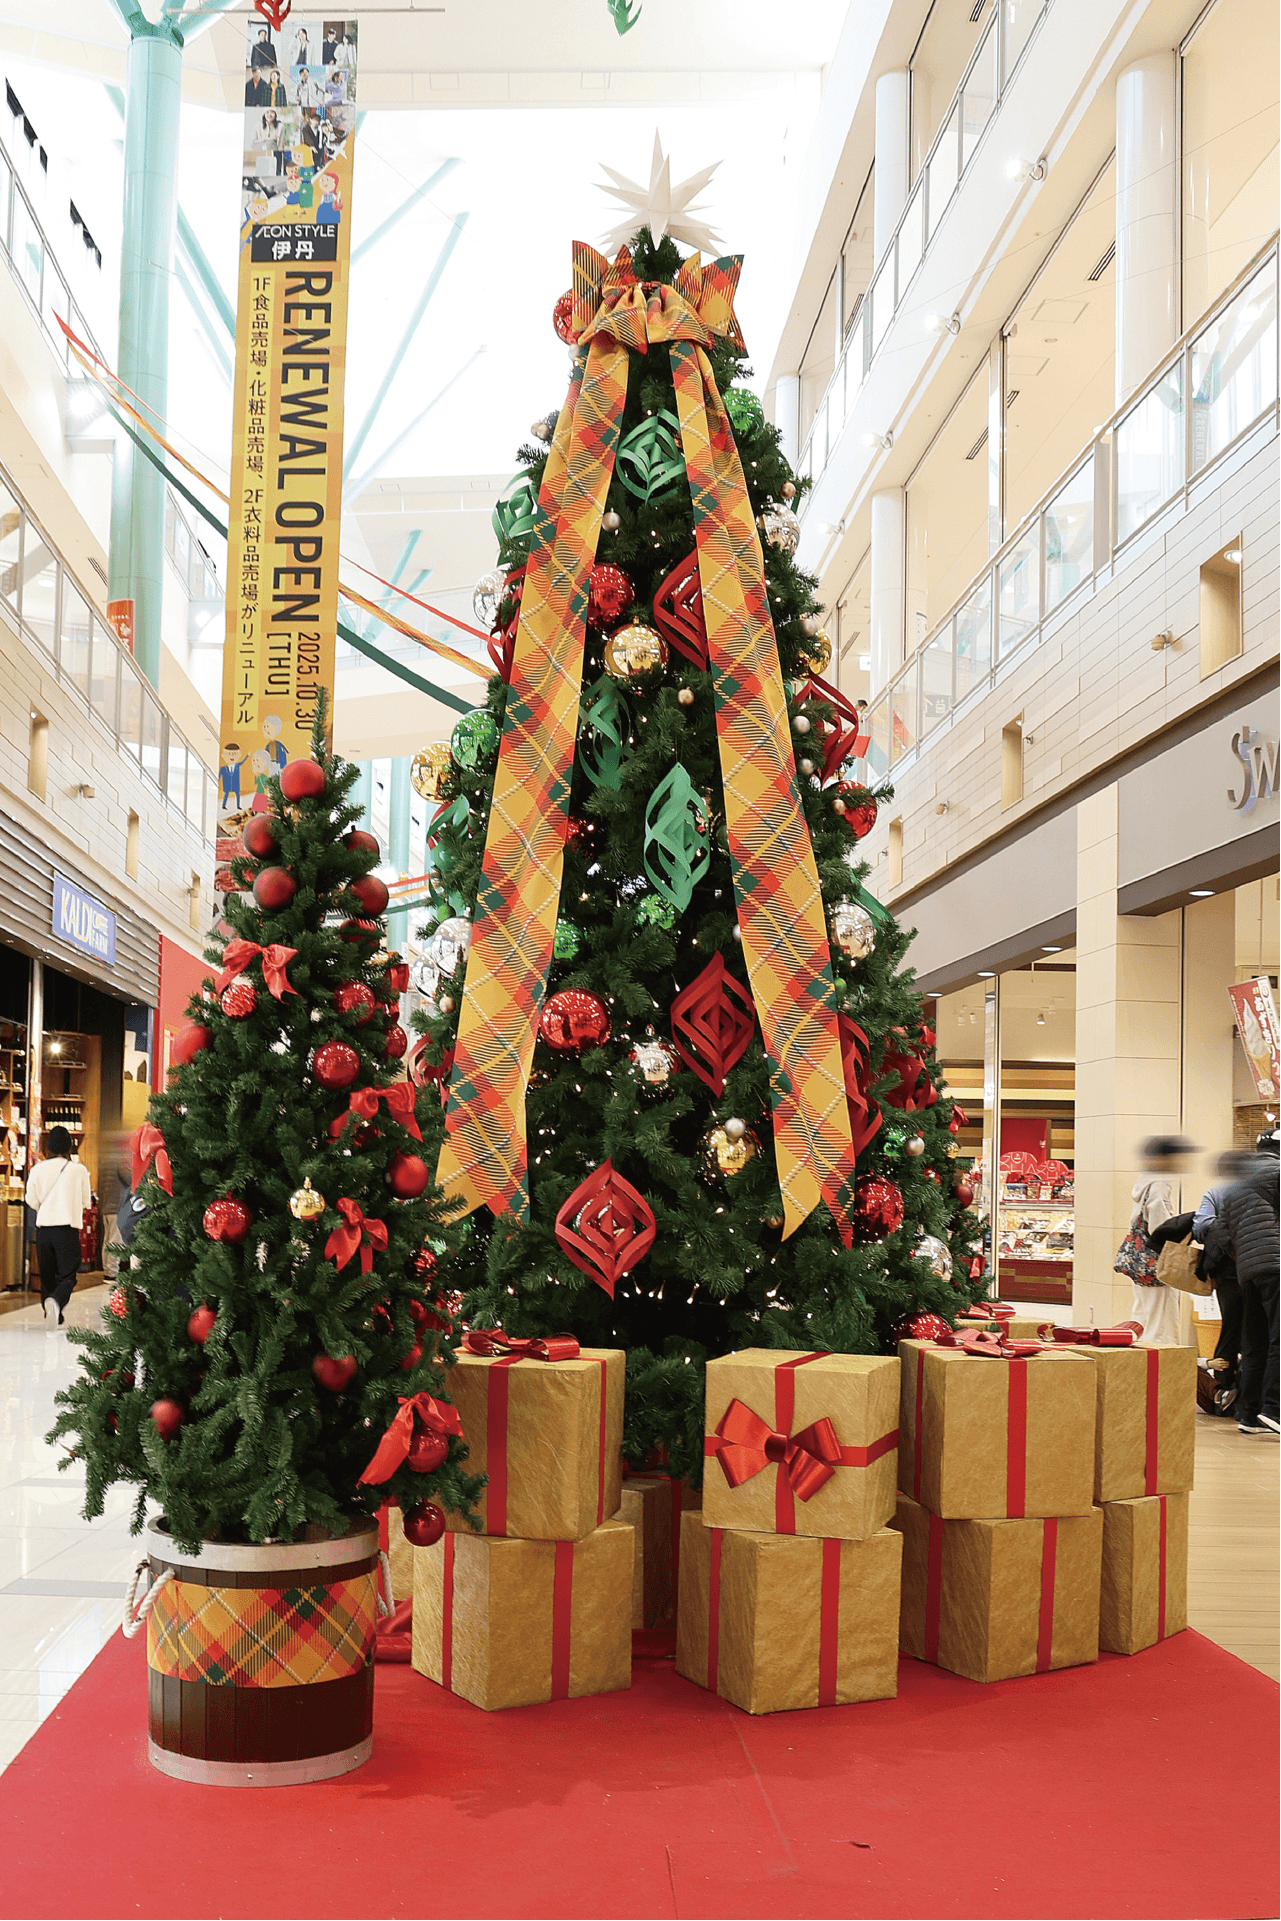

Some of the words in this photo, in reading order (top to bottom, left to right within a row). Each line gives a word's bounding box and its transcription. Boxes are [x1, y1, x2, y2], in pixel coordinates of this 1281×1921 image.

[294, 224, 336, 238] STYLE
[277, 271, 333, 490] RENEWAL
[271, 501, 325, 622] OPEN
[264, 632, 292, 696] [THU]
[295, 631, 321, 730] 2025.10.30
[61, 887, 93, 947] KALDI
